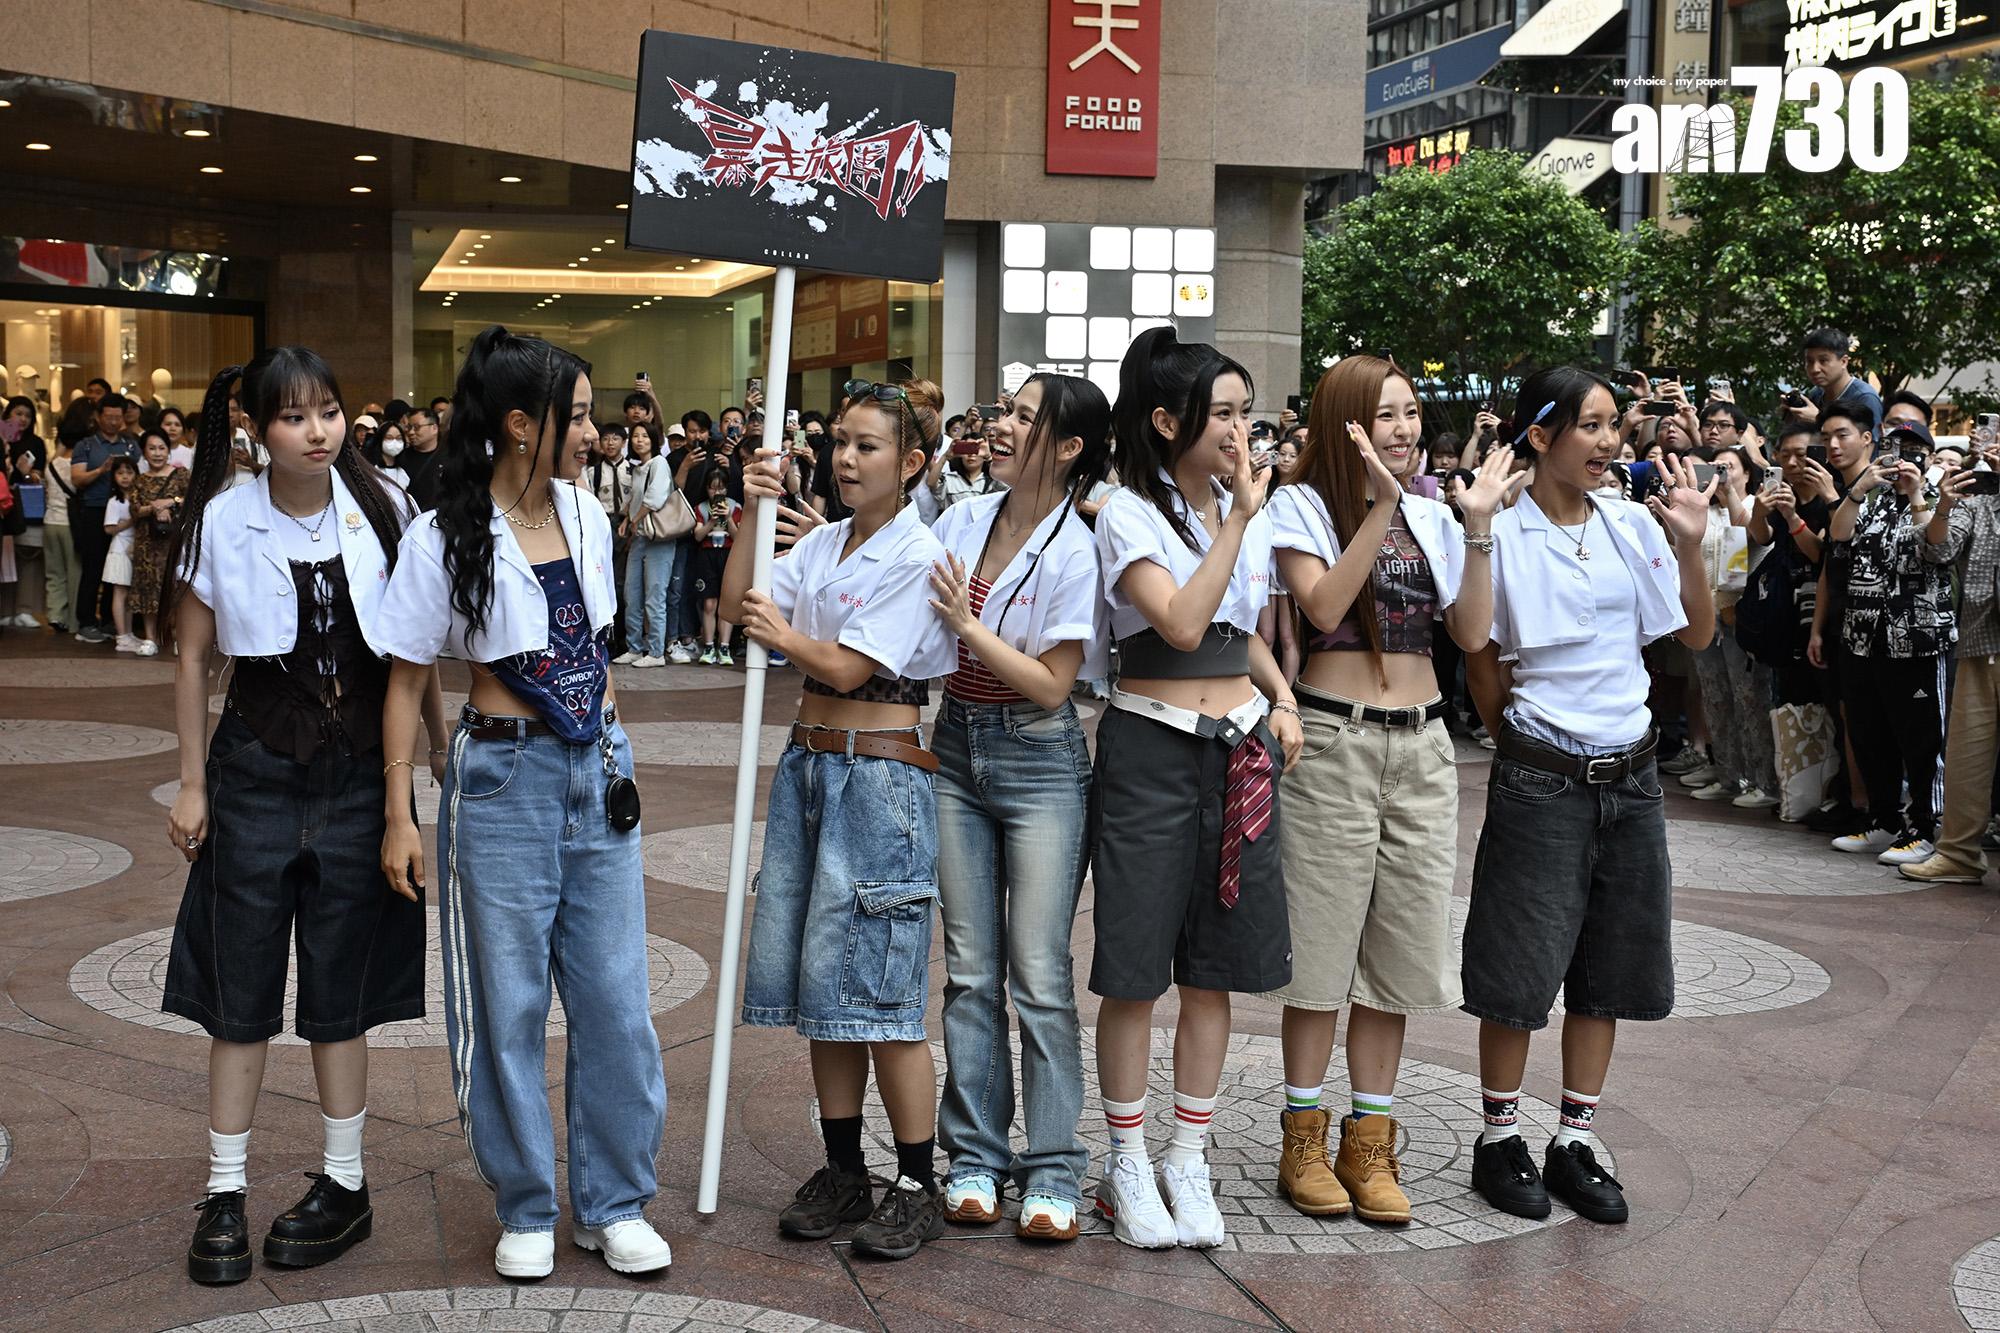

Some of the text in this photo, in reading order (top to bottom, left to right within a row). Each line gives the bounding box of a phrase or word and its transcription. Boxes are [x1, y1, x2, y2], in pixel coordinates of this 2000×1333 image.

[1382, 74, 1430, 102] EuroEyes
[1066, 95, 1142, 113] FOOD
[1065, 114, 1142, 131] FORUM
[560, 670, 594, 687] COWBOY
